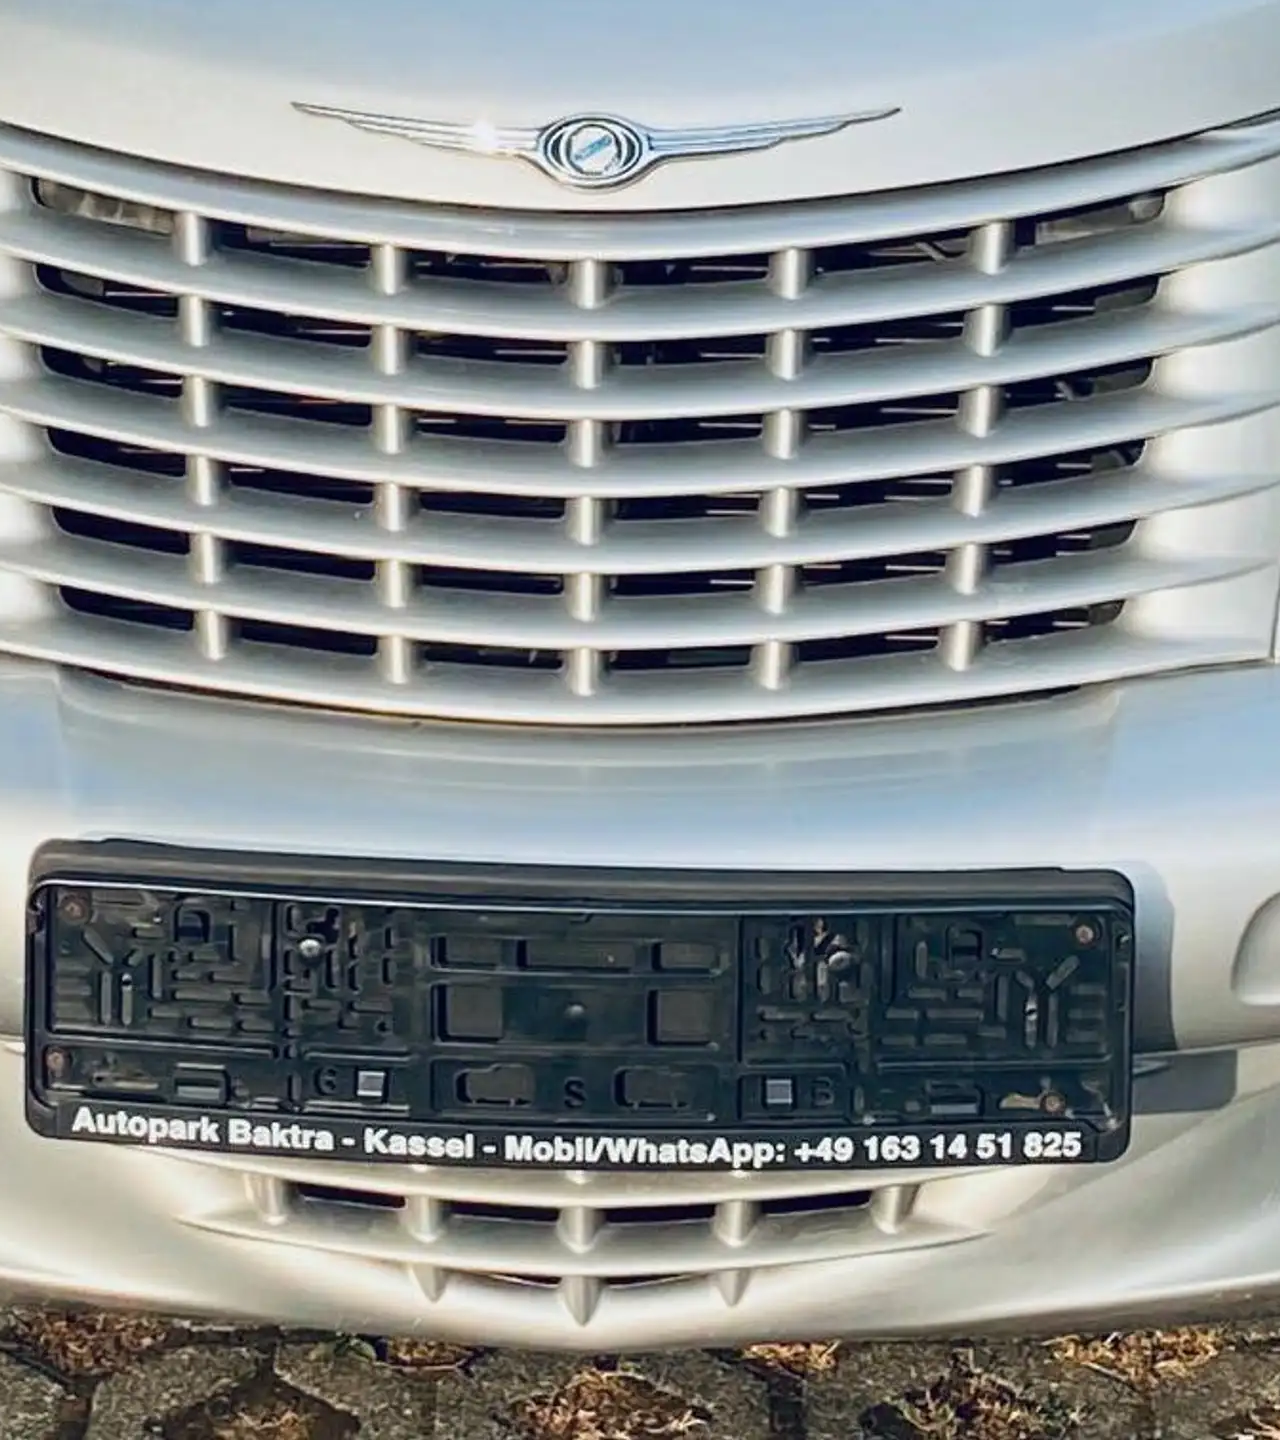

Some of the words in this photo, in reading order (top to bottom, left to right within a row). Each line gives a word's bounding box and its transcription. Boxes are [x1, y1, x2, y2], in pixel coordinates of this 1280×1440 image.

[71, 1106, 220, 1143] Autopark
[228, 1118, 334, 1152] Baktra
[363, 1127, 474, 1159] Kassel
[504, 1135, 786, 1169] Mobil/WhatsApp:
[793, 1136, 855, 1163] +49
[863, 1135, 921, 1161] 163
[929, 1133, 968, 1160] 14
[975, 1132, 1013, 1160] 51
[1022, 1130, 1083, 1158] 825
